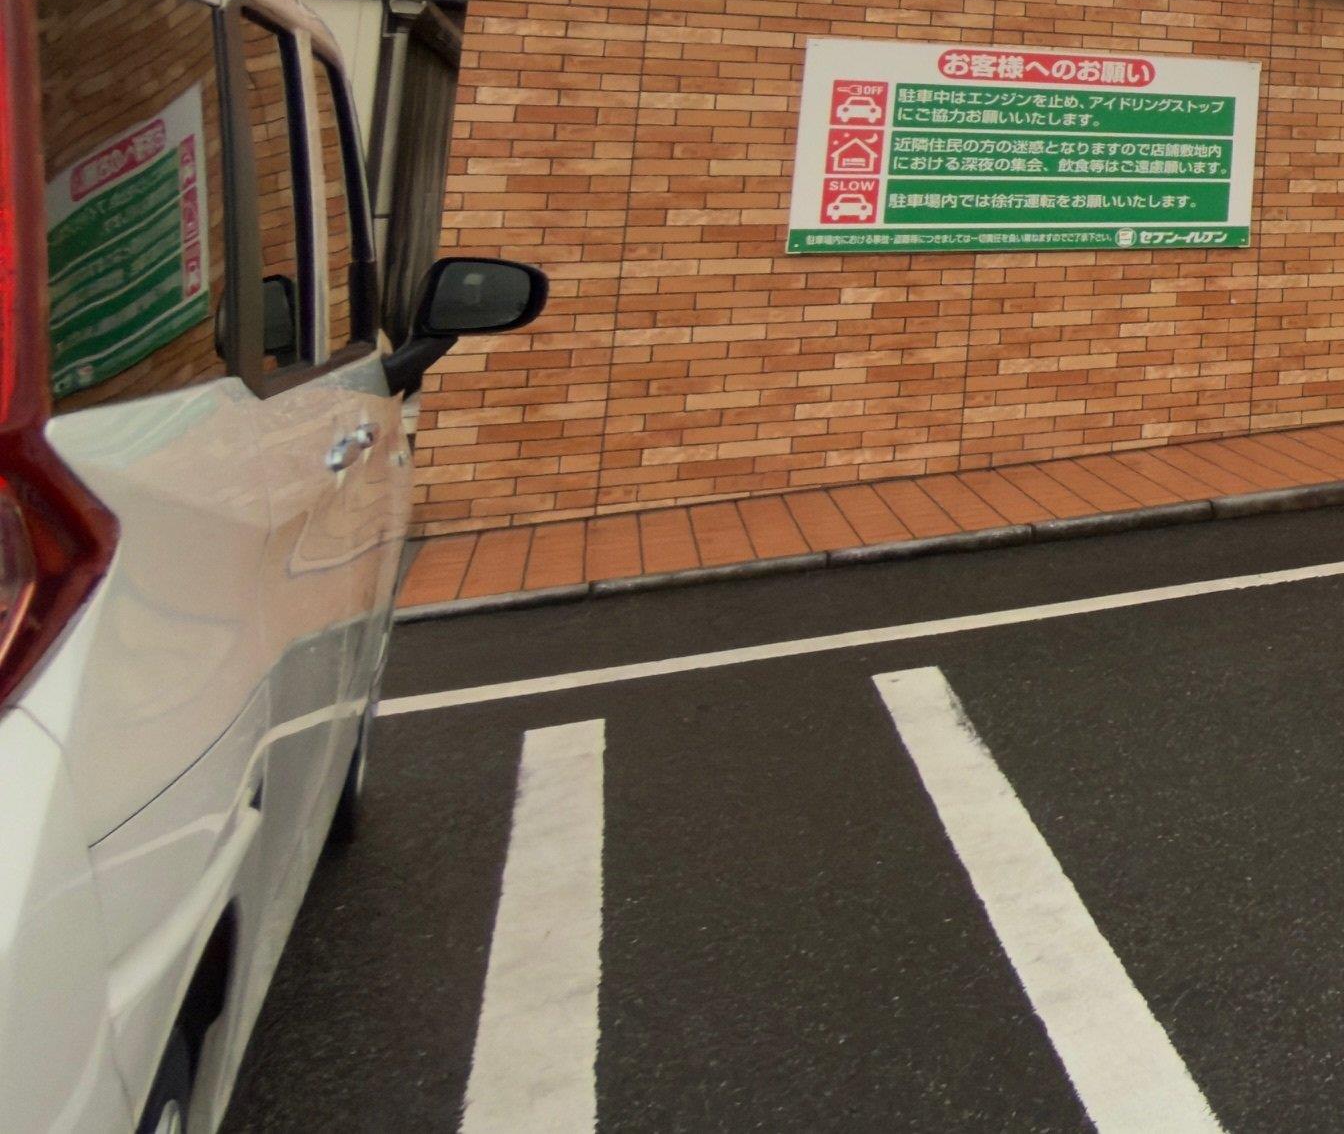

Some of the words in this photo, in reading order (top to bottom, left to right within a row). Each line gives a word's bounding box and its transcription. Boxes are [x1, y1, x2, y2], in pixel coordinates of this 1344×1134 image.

[943, 52, 1151, 84] お客様へのお願い
[863, 85, 883, 95] OFF
[897, 108, 1101, 127] にご協力お願いいたします。
[829, 180, 875, 192] SLOW
[888, 193, 1197, 210] 駐車場内では徐行運転をお願いいたします。
